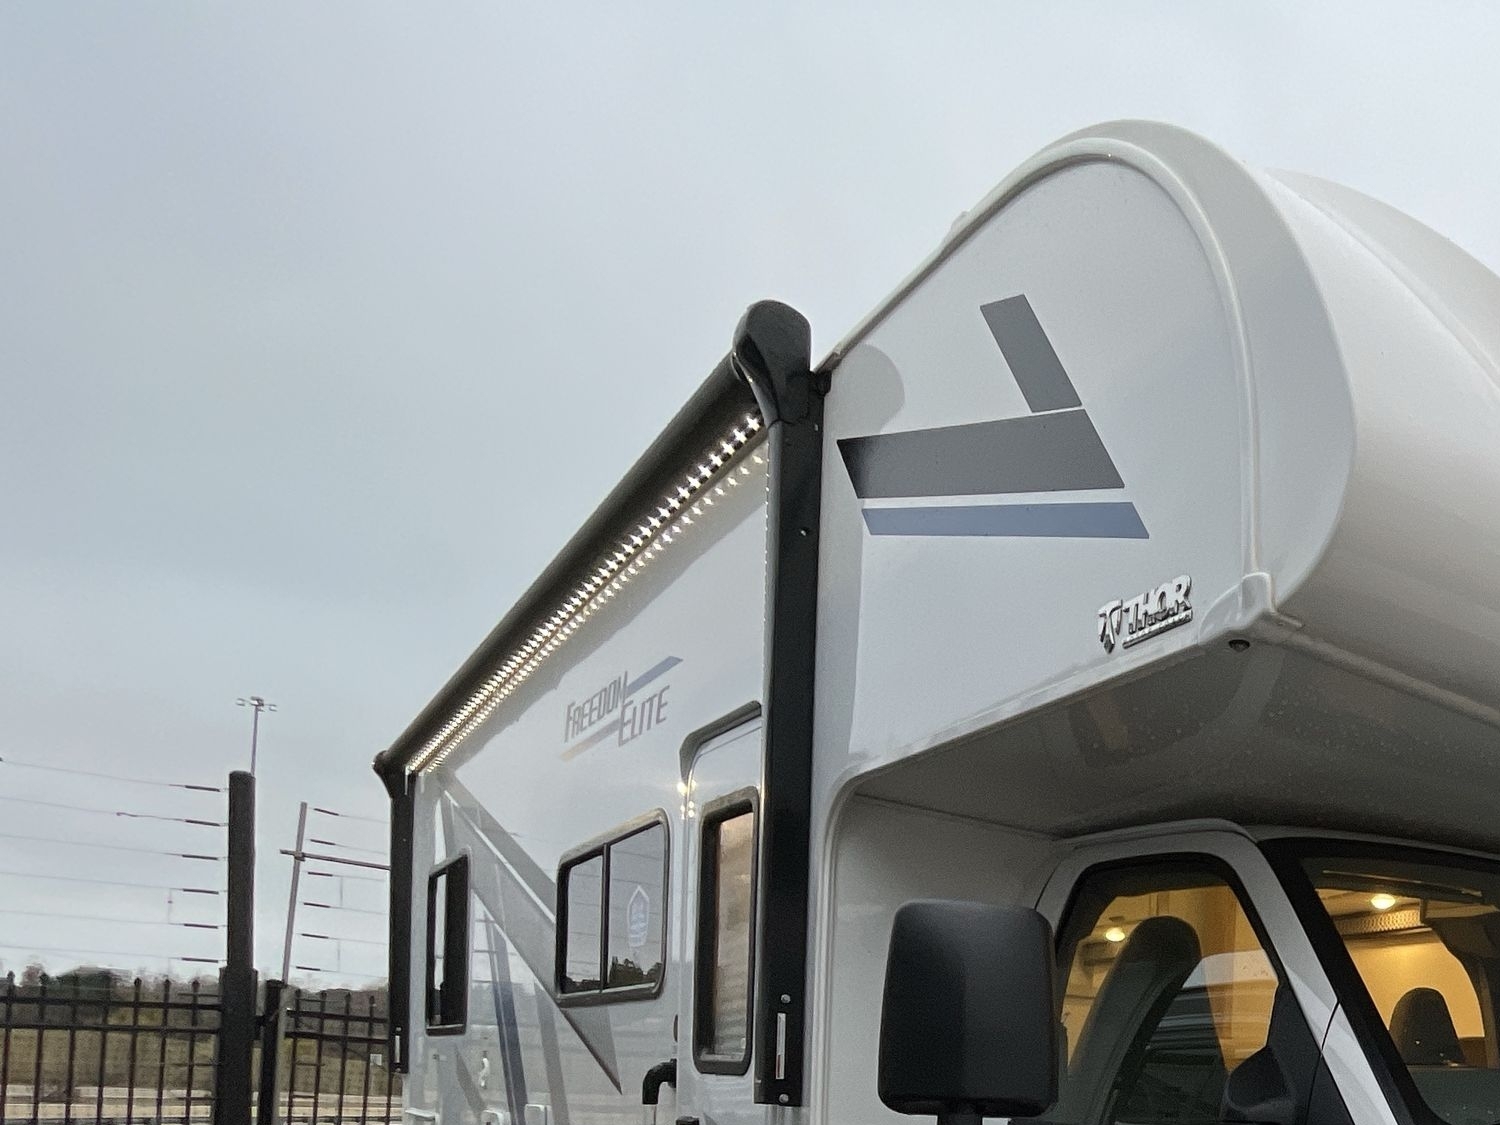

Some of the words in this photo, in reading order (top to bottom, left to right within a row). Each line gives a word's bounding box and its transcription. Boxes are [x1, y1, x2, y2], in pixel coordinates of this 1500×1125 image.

[1122, 575, 1192, 634] THOR
[564, 670, 628, 743] FREEDOM
[618, 685, 670, 747] ELITE
